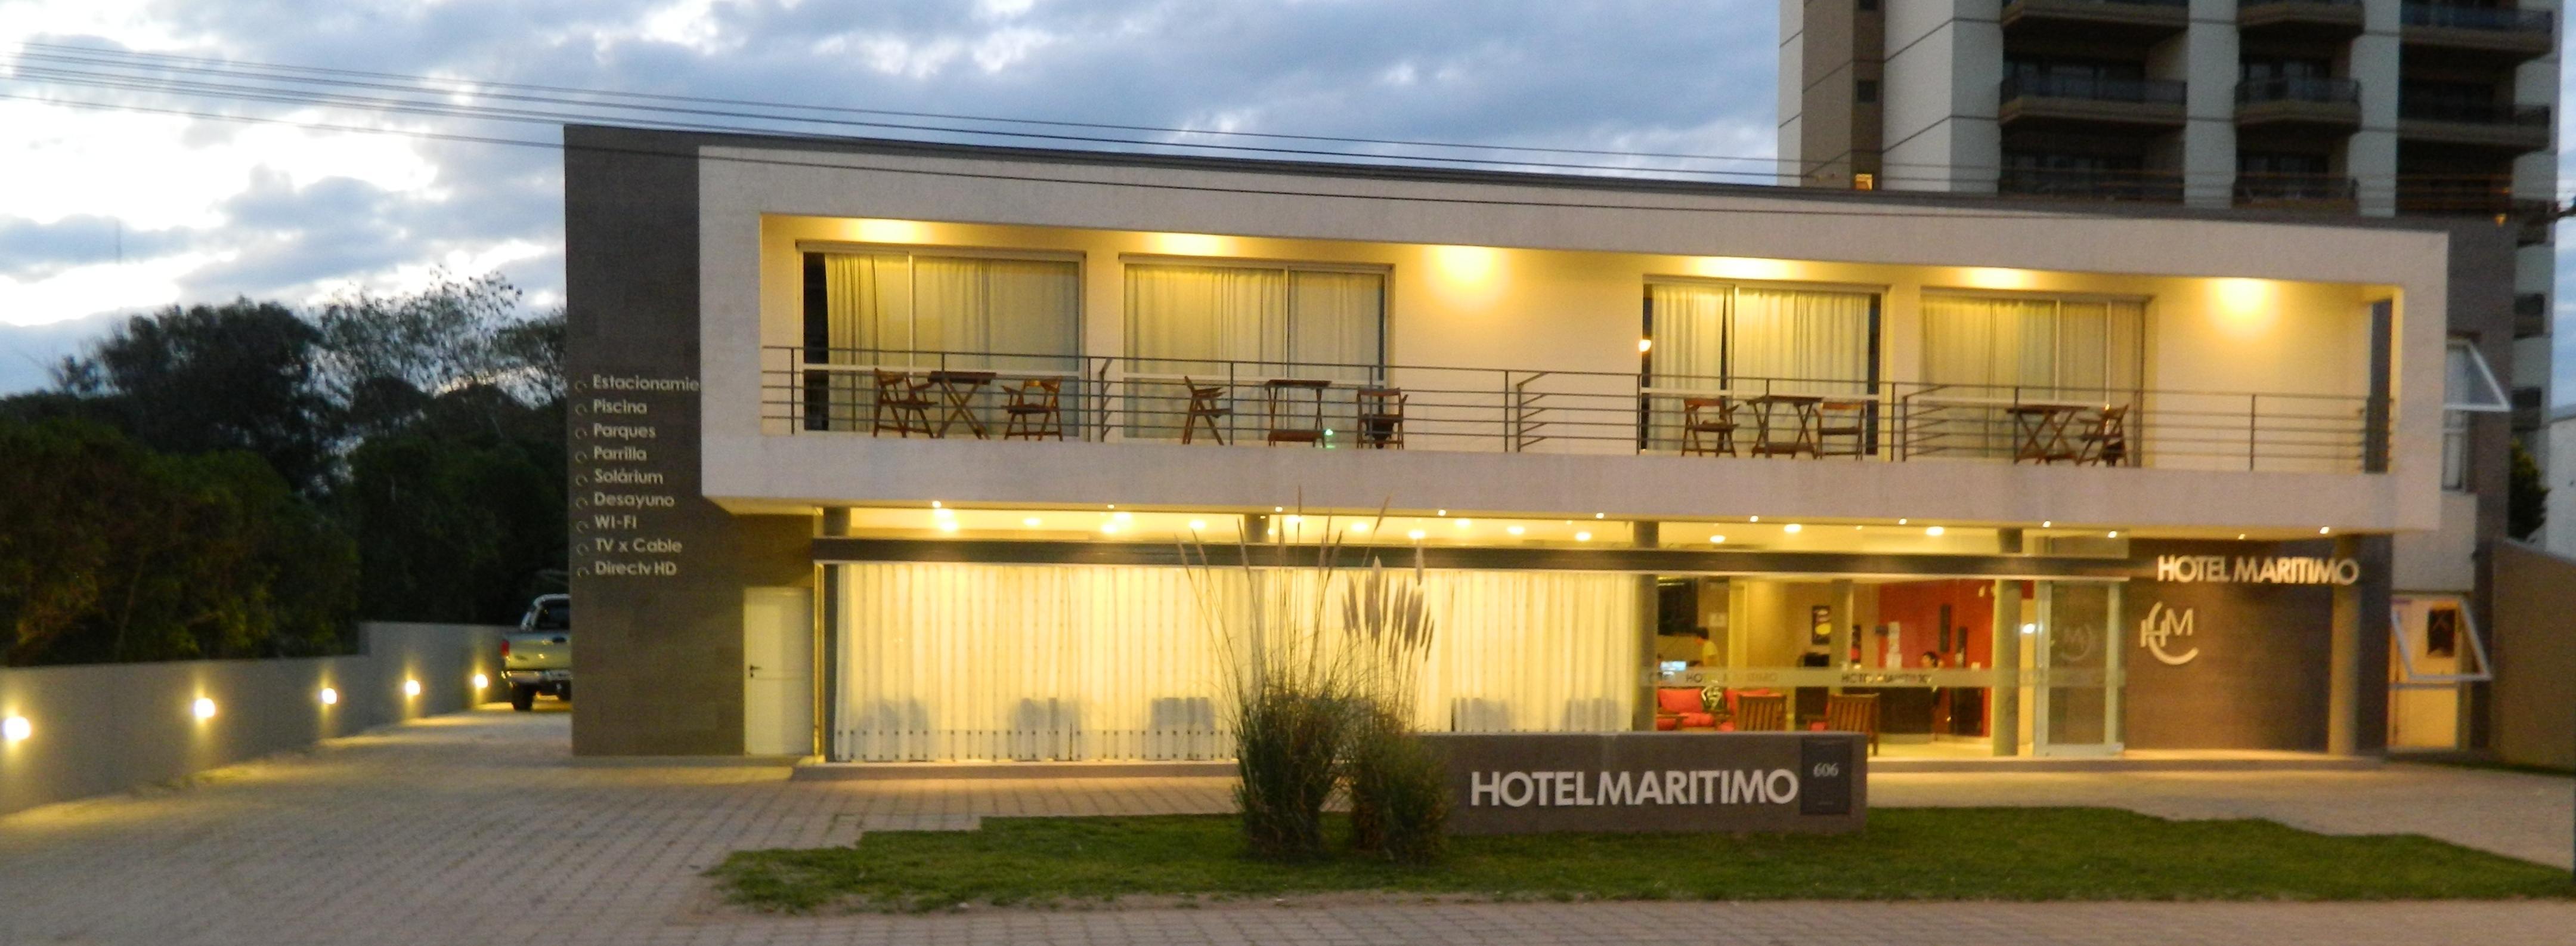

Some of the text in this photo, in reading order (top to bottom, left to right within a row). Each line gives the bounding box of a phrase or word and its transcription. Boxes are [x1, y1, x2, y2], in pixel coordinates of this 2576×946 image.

[593, 374, 699, 391] Estacionamie
[593, 399, 648, 414] Piscina
[593, 423, 656, 440] Parques
[594, 446, 647, 461] Parrilla
[595, 491, 675, 509] Desayuno
[596, 537, 614, 552] TV
[633, 538, 683, 553] Cable
[654, 561, 677, 576] HD
[2157, 555, 2359, 585] HOTEL MARITIMO
[1813, 762, 1839, 777] 606
[1470, 768, 1799, 807] HOTEL MARITIMO
